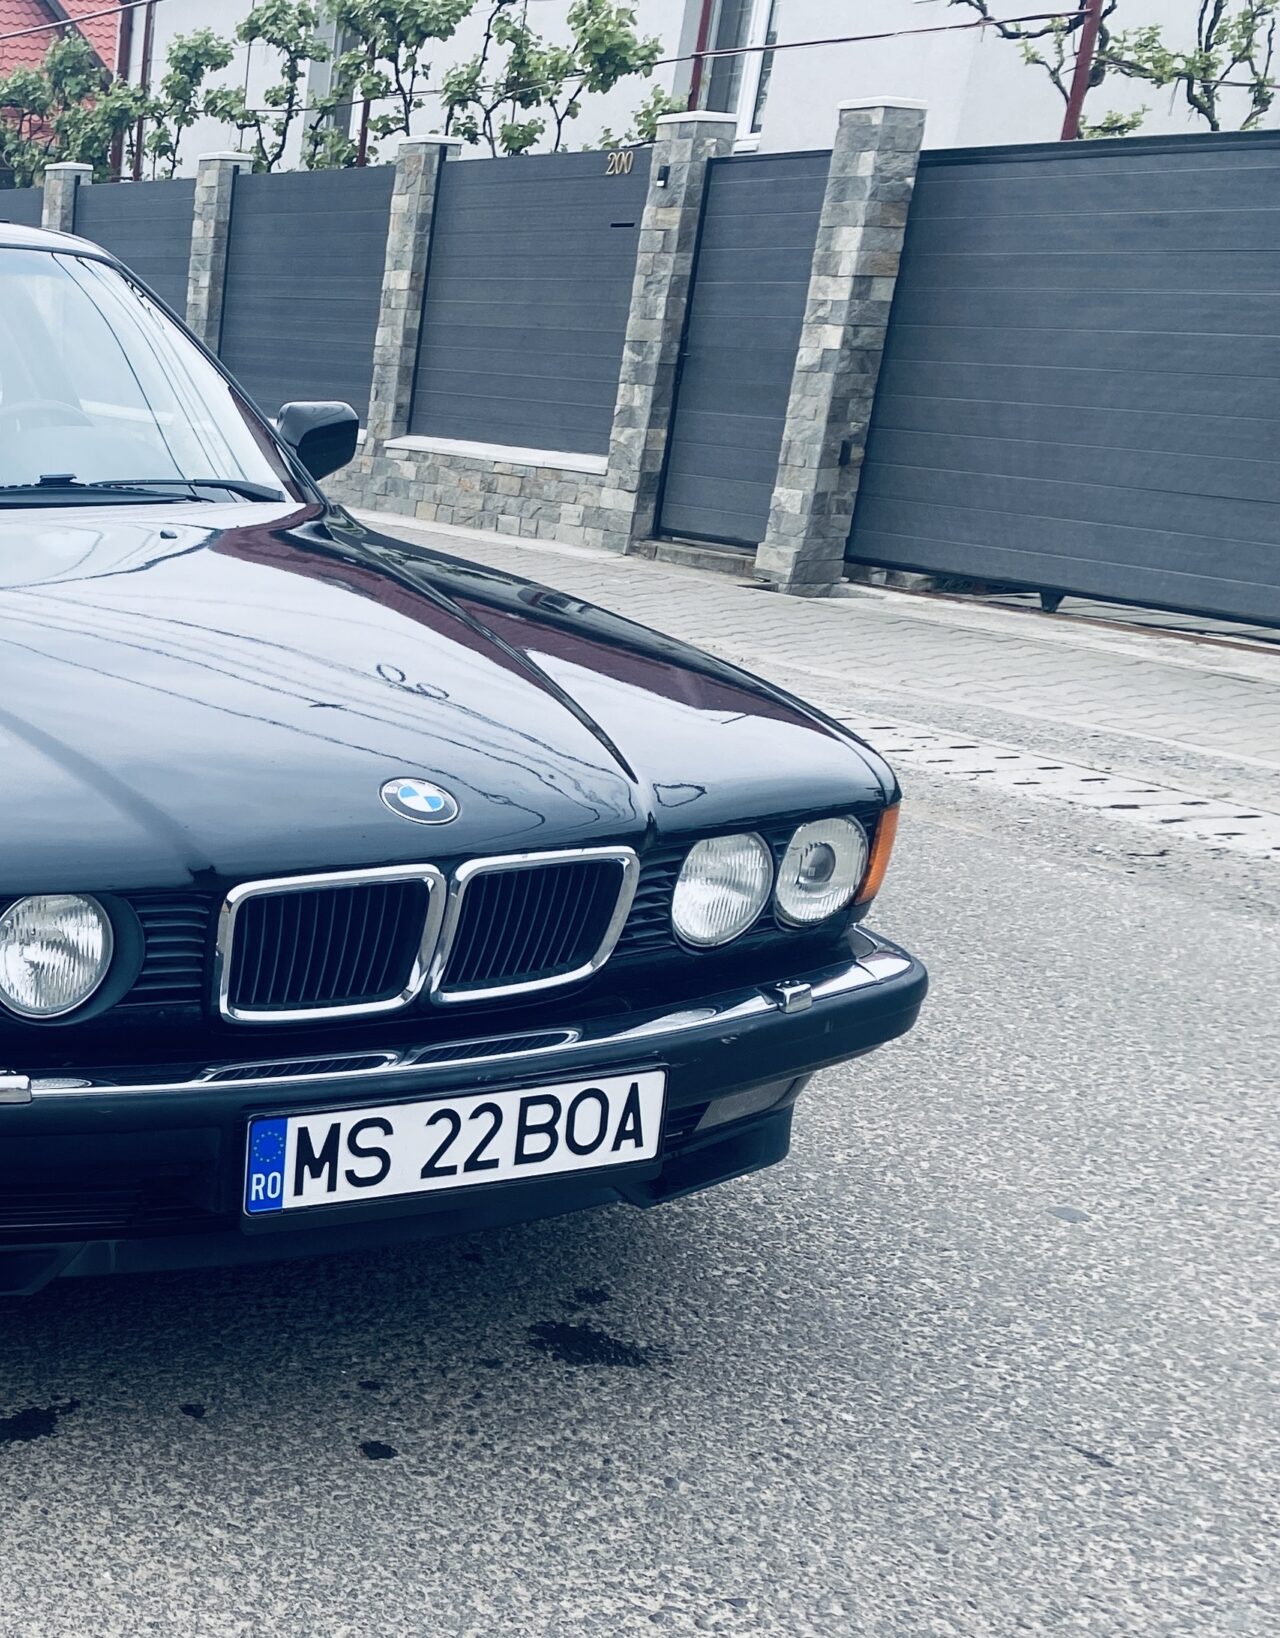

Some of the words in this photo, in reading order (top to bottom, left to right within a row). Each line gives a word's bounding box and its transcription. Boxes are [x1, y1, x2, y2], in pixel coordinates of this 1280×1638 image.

[606, 150, 634, 175] 200
[293, 1117, 394, 1197] MS
[251, 1171, 282, 1201] RO
